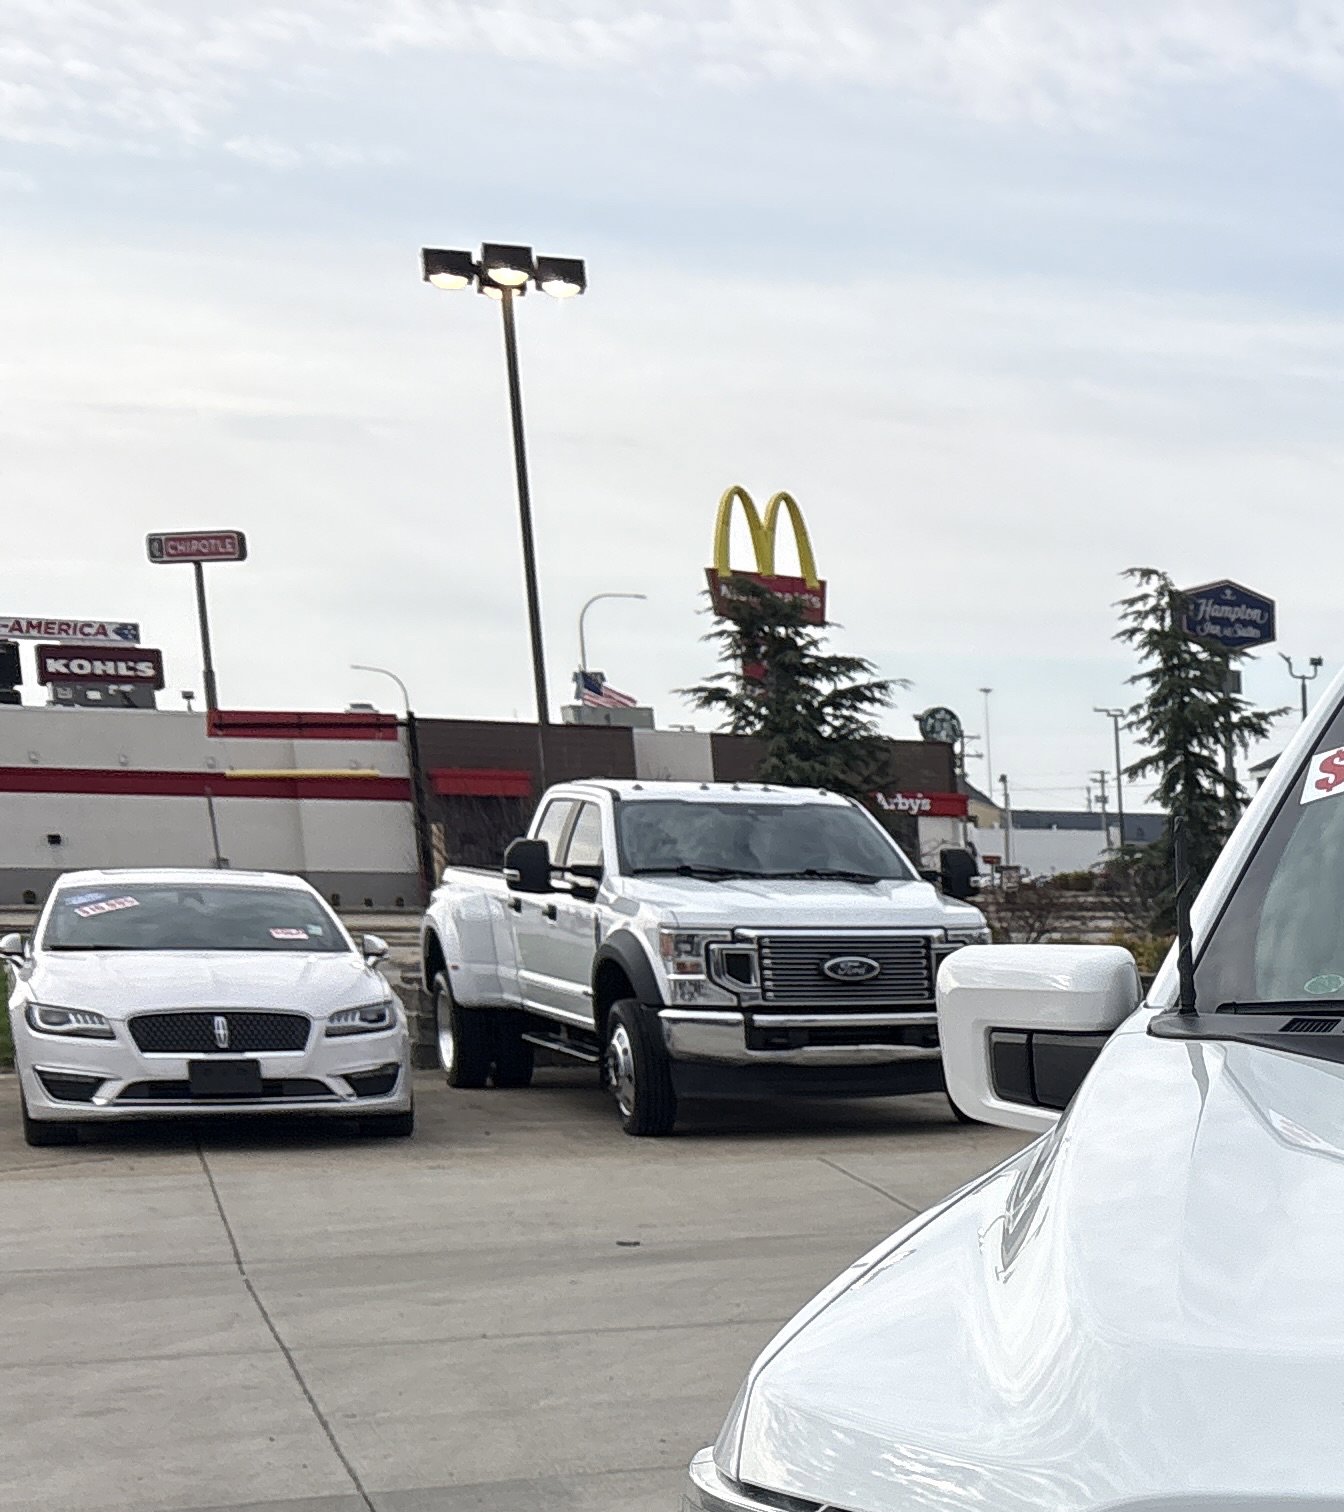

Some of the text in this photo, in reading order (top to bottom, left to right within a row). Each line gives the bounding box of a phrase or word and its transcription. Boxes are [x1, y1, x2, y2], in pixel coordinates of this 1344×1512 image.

[167, 538, 235, 555] CHIPOTLE
[1196, 599, 1268, 623] Hampton
[46, 657, 156, 677] KOHL'S
